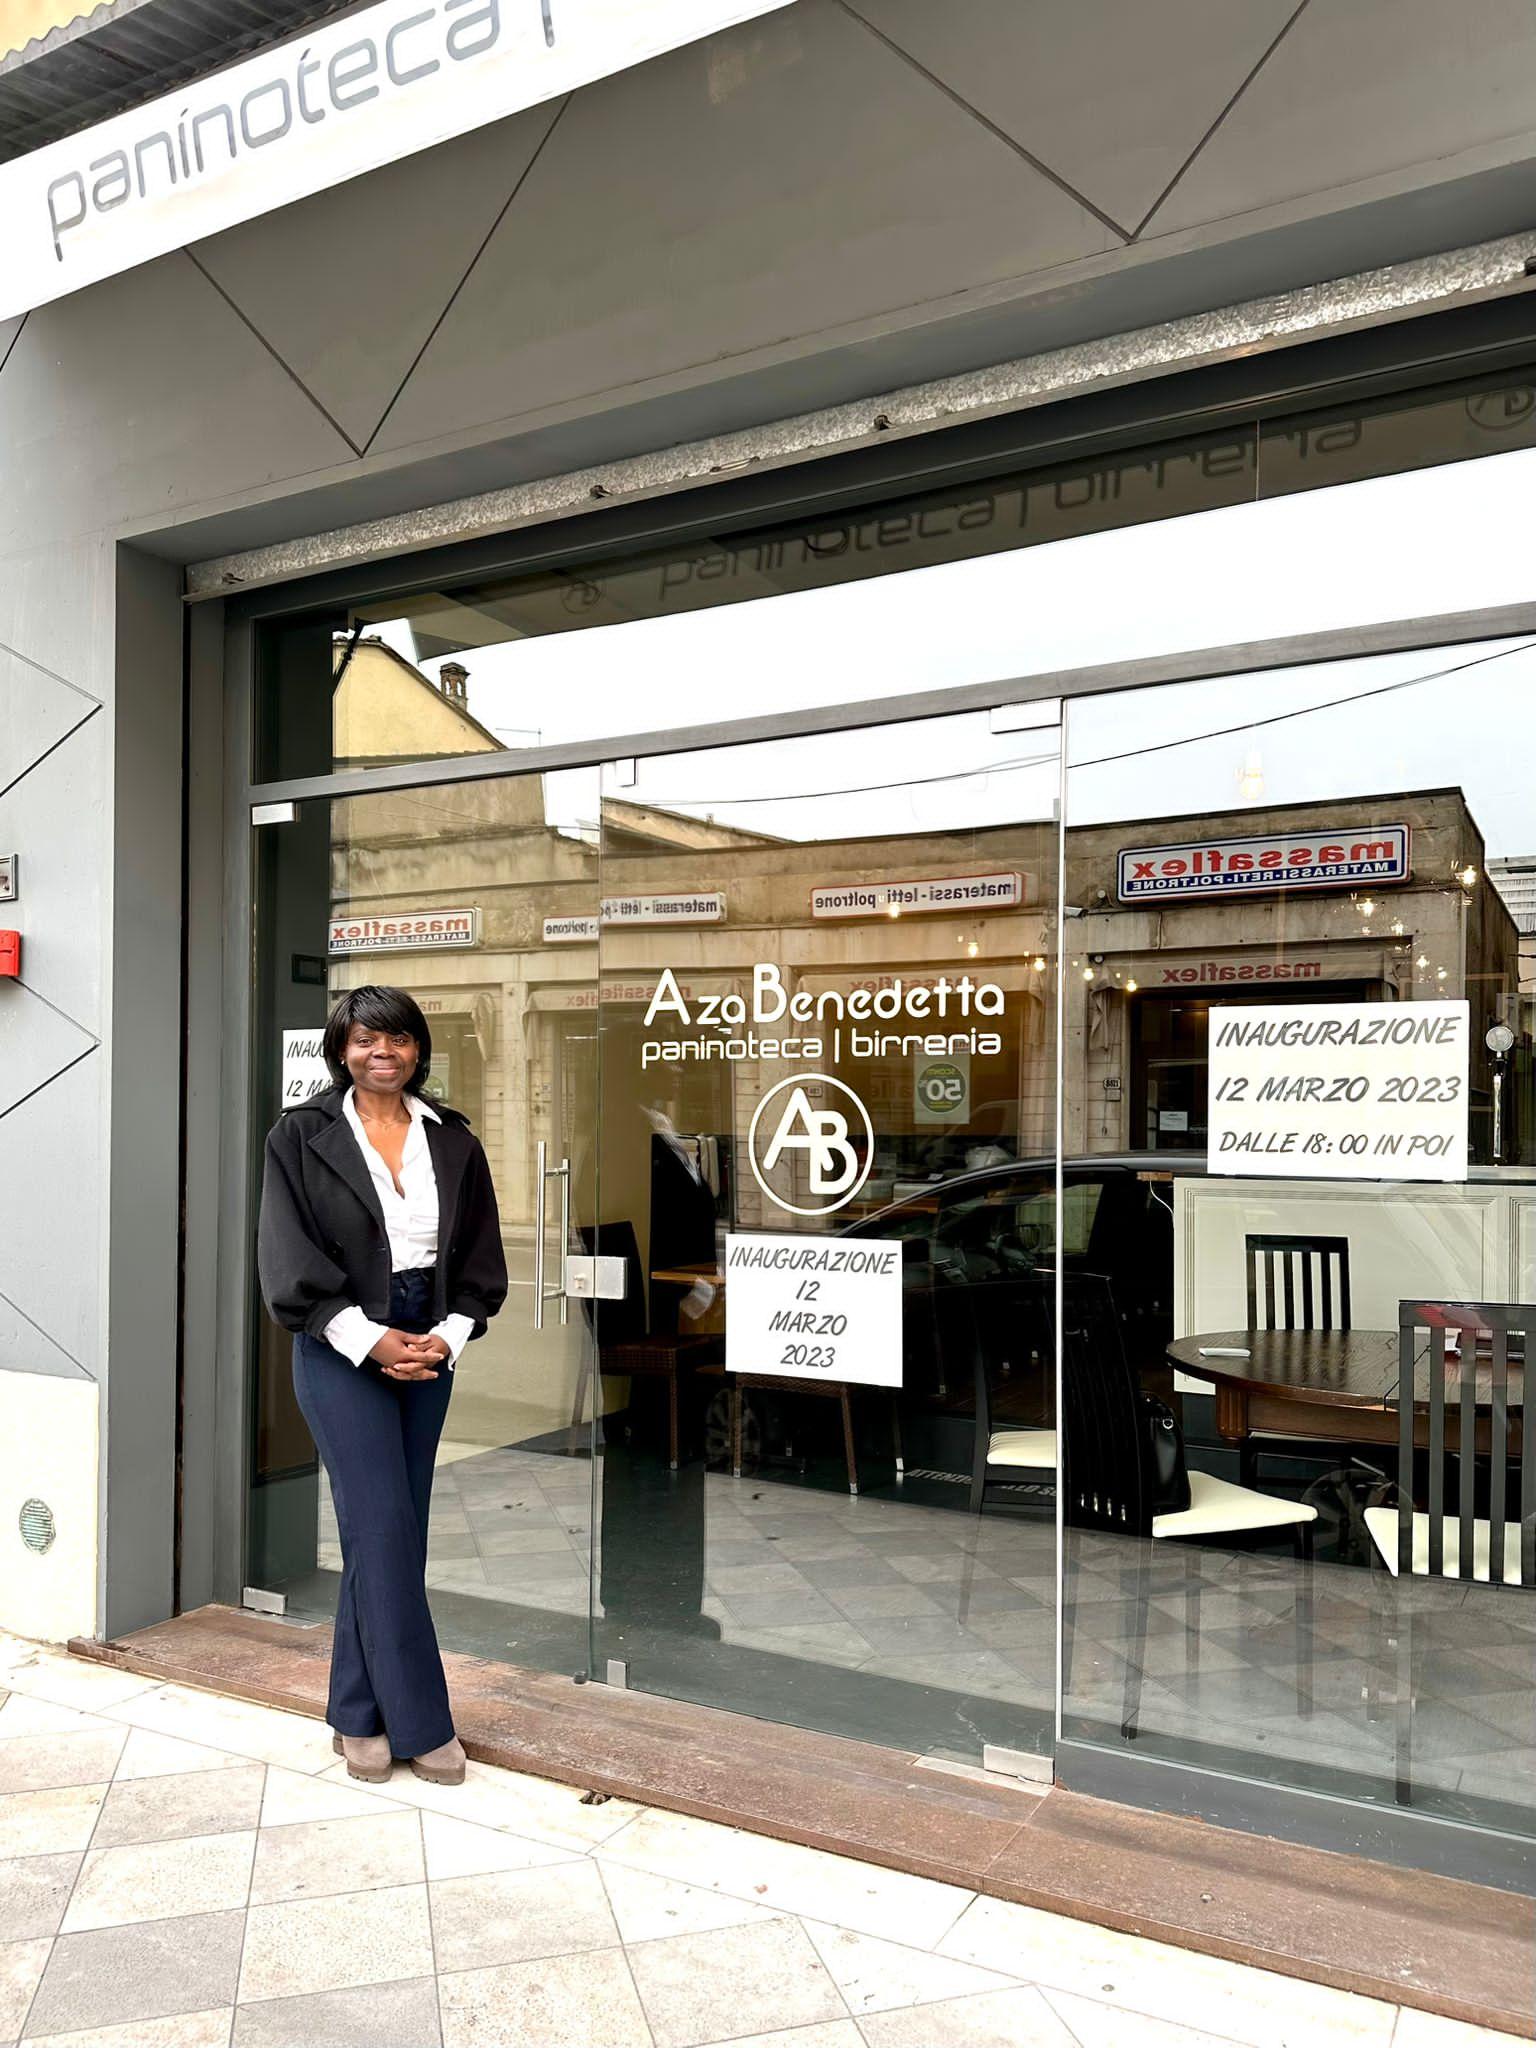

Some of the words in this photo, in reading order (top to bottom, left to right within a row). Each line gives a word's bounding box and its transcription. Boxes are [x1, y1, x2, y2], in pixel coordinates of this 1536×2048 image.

[47, 0, 500, 262] paninoteca
[753, 962, 1005, 1024] Benedetta
[1216, 1016, 1462, 1047] INAUGURAZIONE
[641, 1030, 823, 1069] paninoteca
[851, 1027, 1002, 1057] birreria
[286, 1079, 303, 1097] 12
[1215, 1077, 1249, 1101] 12
[1256, 1076, 1370, 1102] MARZO
[1377, 1076, 1462, 1102] 2023
[762, 1086, 859, 1195] AB
[1219, 1131, 1299, 1152] DALLE
[1373, 1134, 1404, 1155] IN
[1407, 1134, 1455, 1156] POI
[729, 1246, 897, 1275] INAUGURAZIONE
[795, 1280, 821, 1302] 12
[768, 1311, 848, 1336] MARZO
[780, 1344, 837, 1368] 2023
